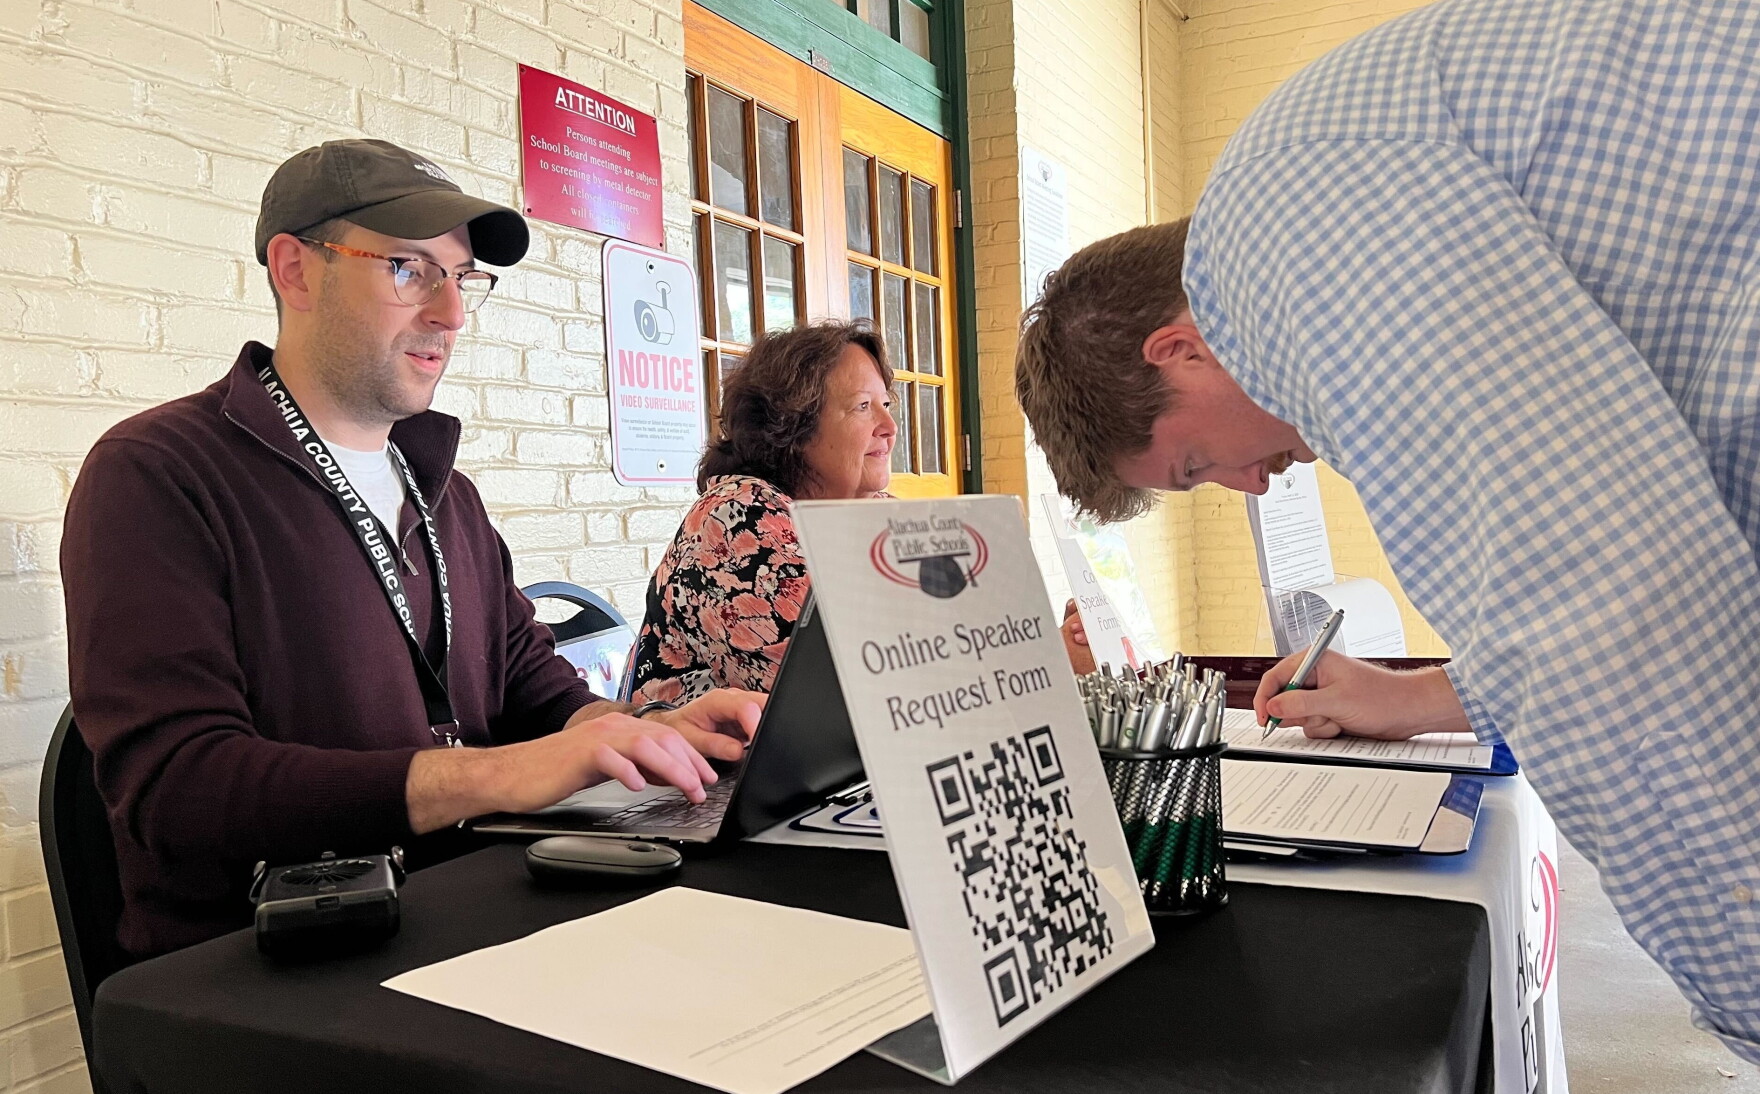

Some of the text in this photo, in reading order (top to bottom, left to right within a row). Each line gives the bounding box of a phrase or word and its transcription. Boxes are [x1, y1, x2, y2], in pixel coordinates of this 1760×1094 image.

[555, 86, 636, 134] ATTENTION
[530, 135, 658, 186] School Board meetings are subject
[566, 126, 631, 160] Persons attending
[540, 159, 653, 201] to screening by metal detector.
[561, 183, 575, 197] All
[570, 206, 587, 219] will
[618, 349, 695, 393] NOTICE
[620, 394, 696, 413] VIDEO SURVEILLANCE
[304, 442, 367, 513] COUNTY
[357, 517, 399, 591] PUBLIC
[393, 592, 418, 642] SCH
[861, 613, 1042, 675] Online Speaker
[885, 665, 1053, 732] Request Form
